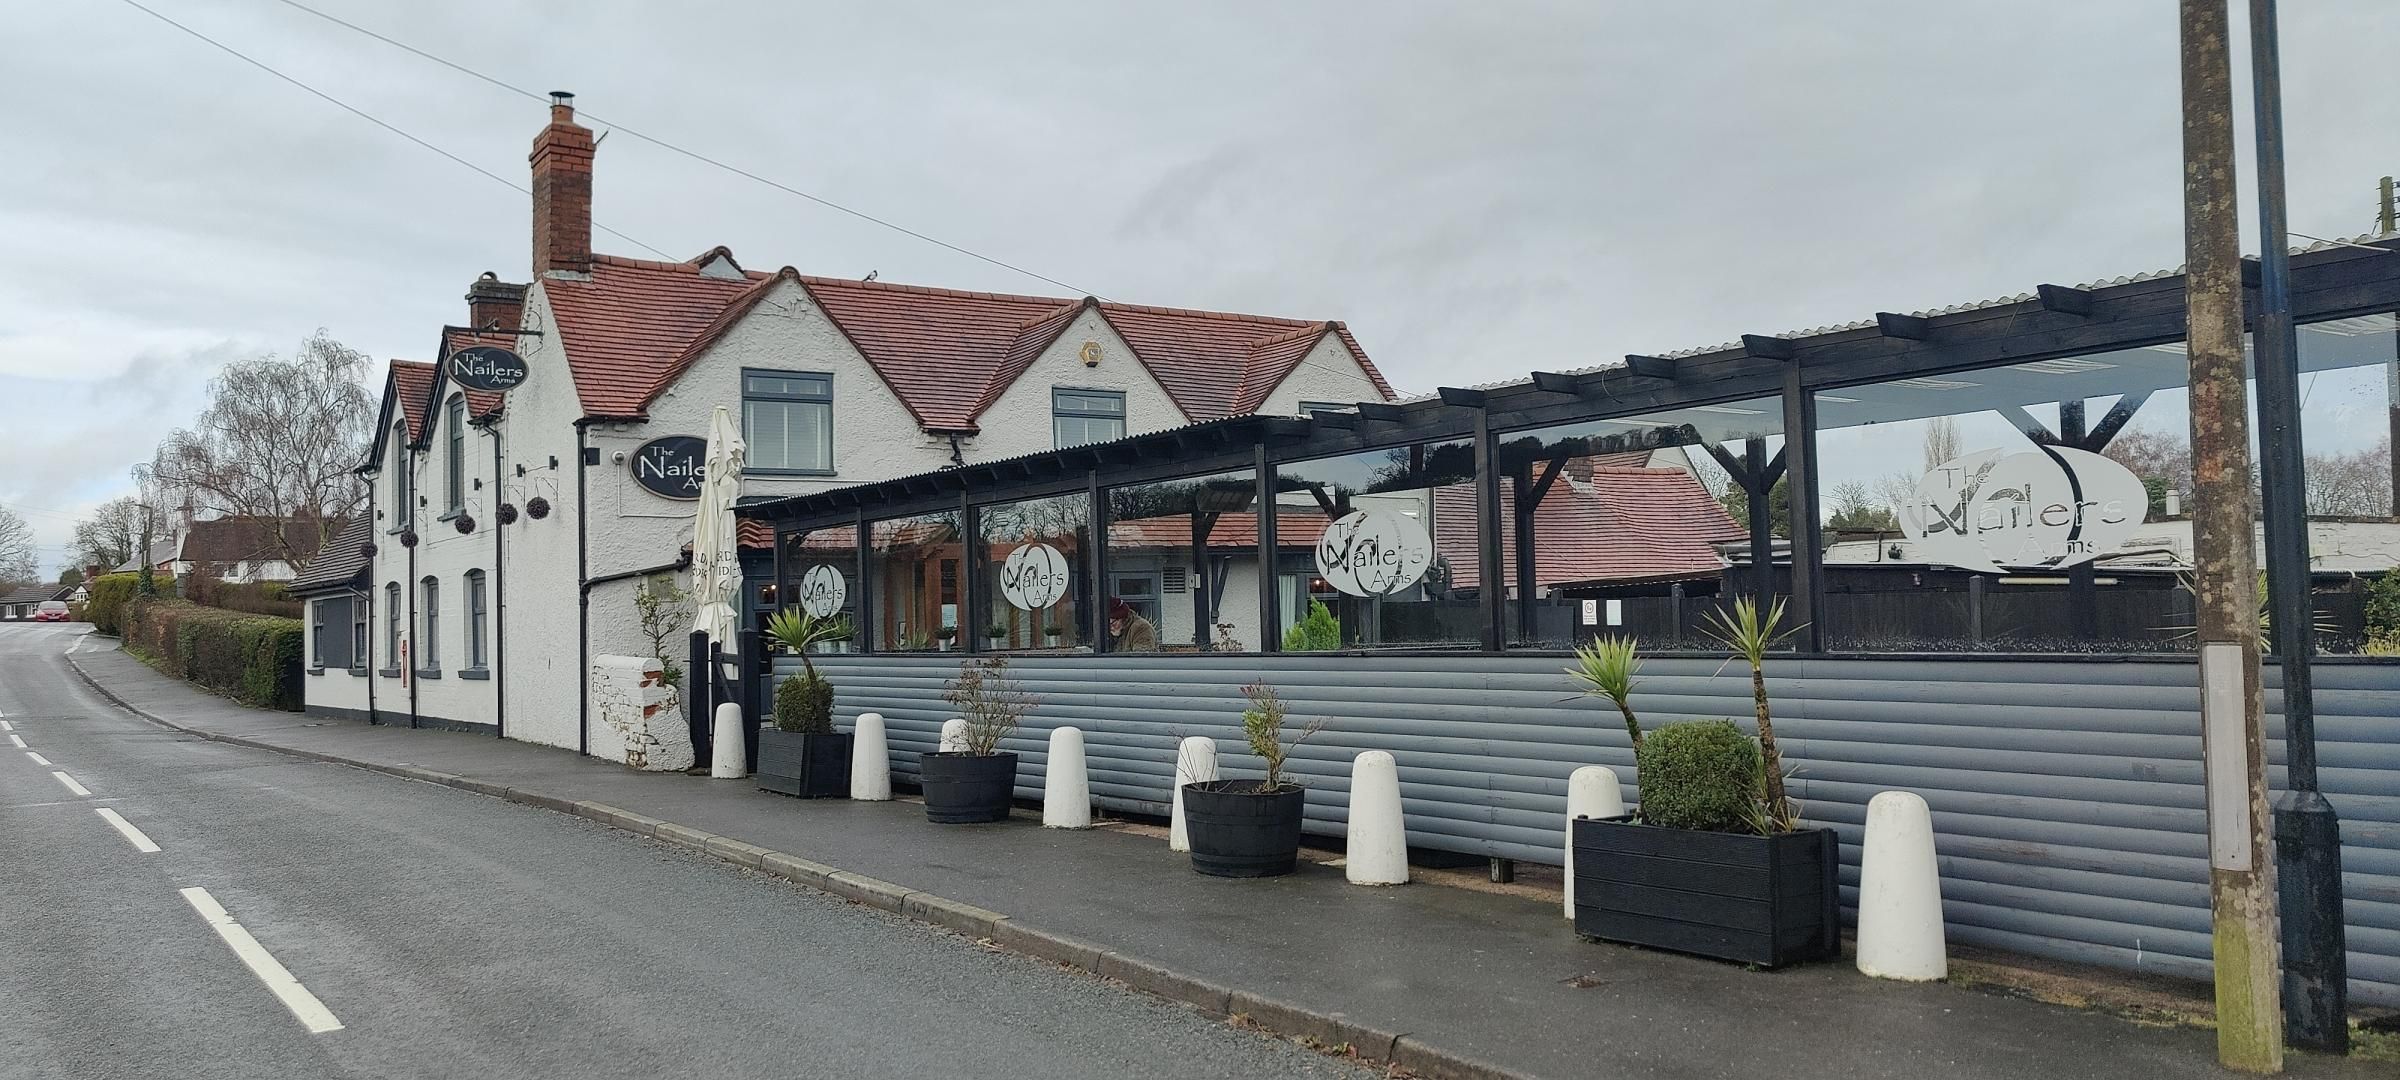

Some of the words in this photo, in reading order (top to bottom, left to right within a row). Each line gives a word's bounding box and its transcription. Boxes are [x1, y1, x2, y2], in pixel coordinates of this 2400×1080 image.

[463, 352, 484, 362] The
[454, 358, 524, 377] Nailers
[650, 446, 675, 457] The
[640, 454, 706, 479] Naile
[1938, 466, 1989, 488] The
[1334, 522, 1361, 538] The
[1326, 534, 1424, 576] Nailers
[1006, 562, 1064, 594] Nailers
[1370, 569, 1412, 589] Arms
[1033, 589, 1057, 605] Arms
